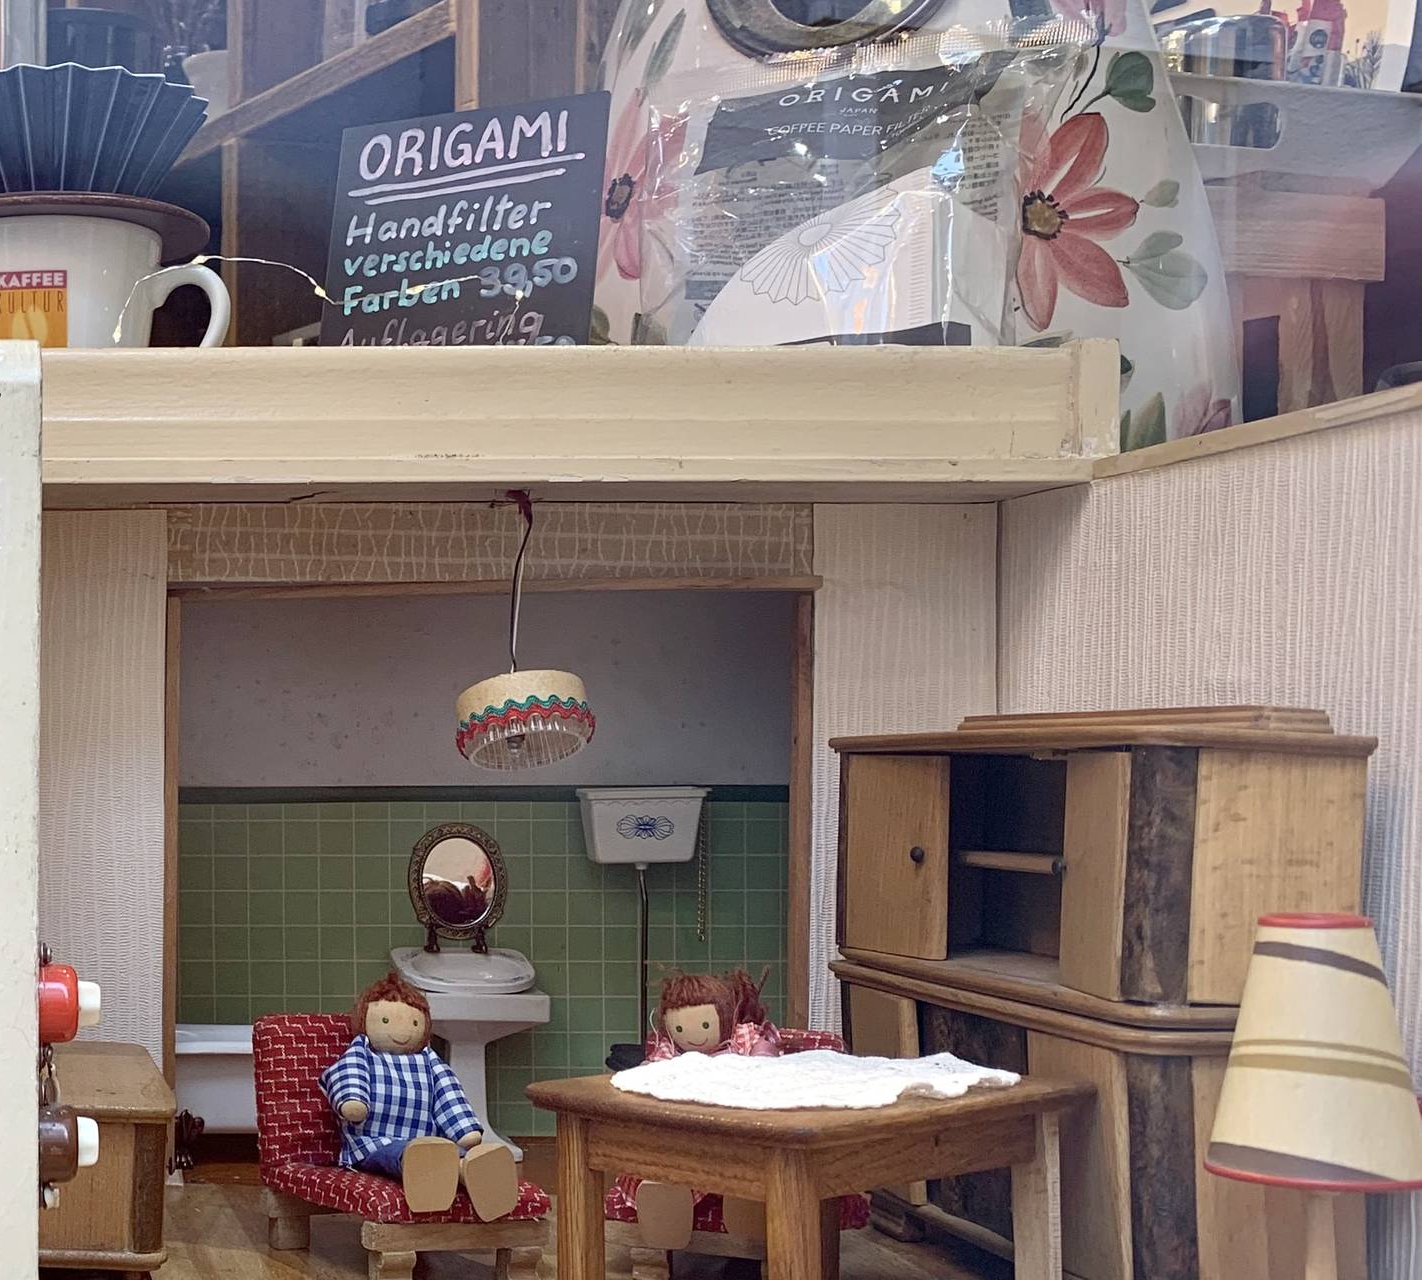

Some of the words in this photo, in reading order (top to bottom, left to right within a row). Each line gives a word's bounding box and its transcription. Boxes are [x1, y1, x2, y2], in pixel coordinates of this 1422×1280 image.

[779, 81, 949, 107] ORIGAMI
[839, 107, 878, 115] JAPAN
[359, 110, 568, 180] ORIGAMI
[768, 122, 826, 136] COFFEE
[829, 123, 883, 136] PAPER
[345, 194, 552, 246] Handfilter
[344, 230, 553, 278] verschiedene
[343, 278, 460, 316] Farben
[479, 256, 578, 298] 39,50
